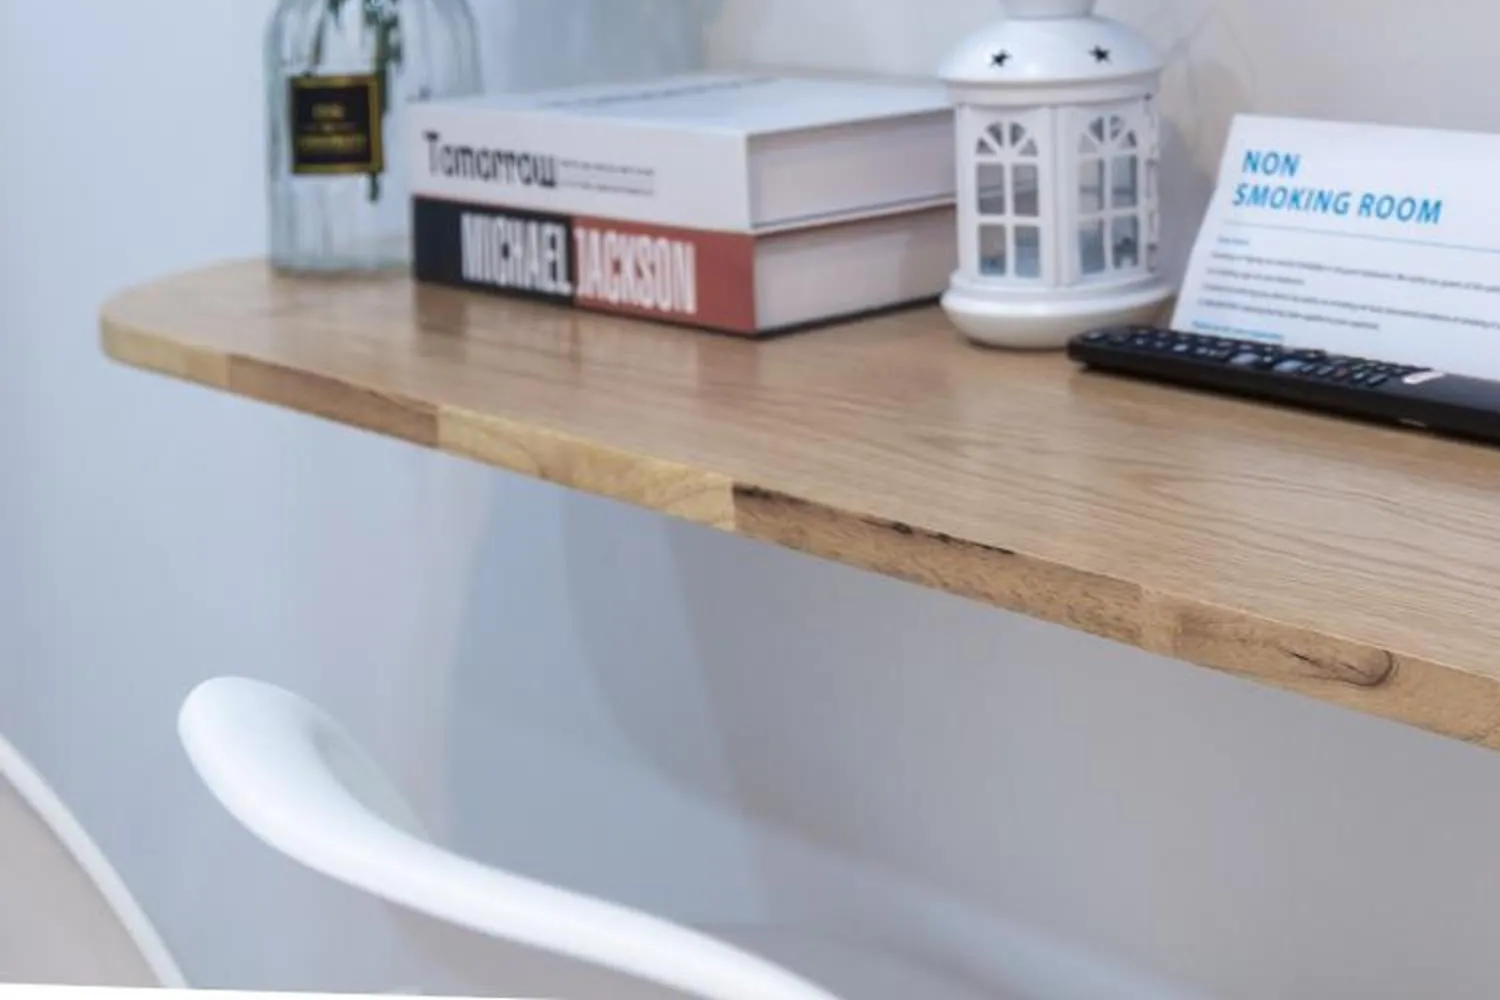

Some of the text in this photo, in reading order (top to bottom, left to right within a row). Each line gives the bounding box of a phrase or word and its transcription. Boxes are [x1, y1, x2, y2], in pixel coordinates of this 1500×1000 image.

[423, 130, 557, 189] Tomorrow
[1241, 150, 1300, 177] NON
[1232, 183, 1442, 225] SMOKING ROOM
[460, 211, 697, 315] MICHAEL JACKSON
